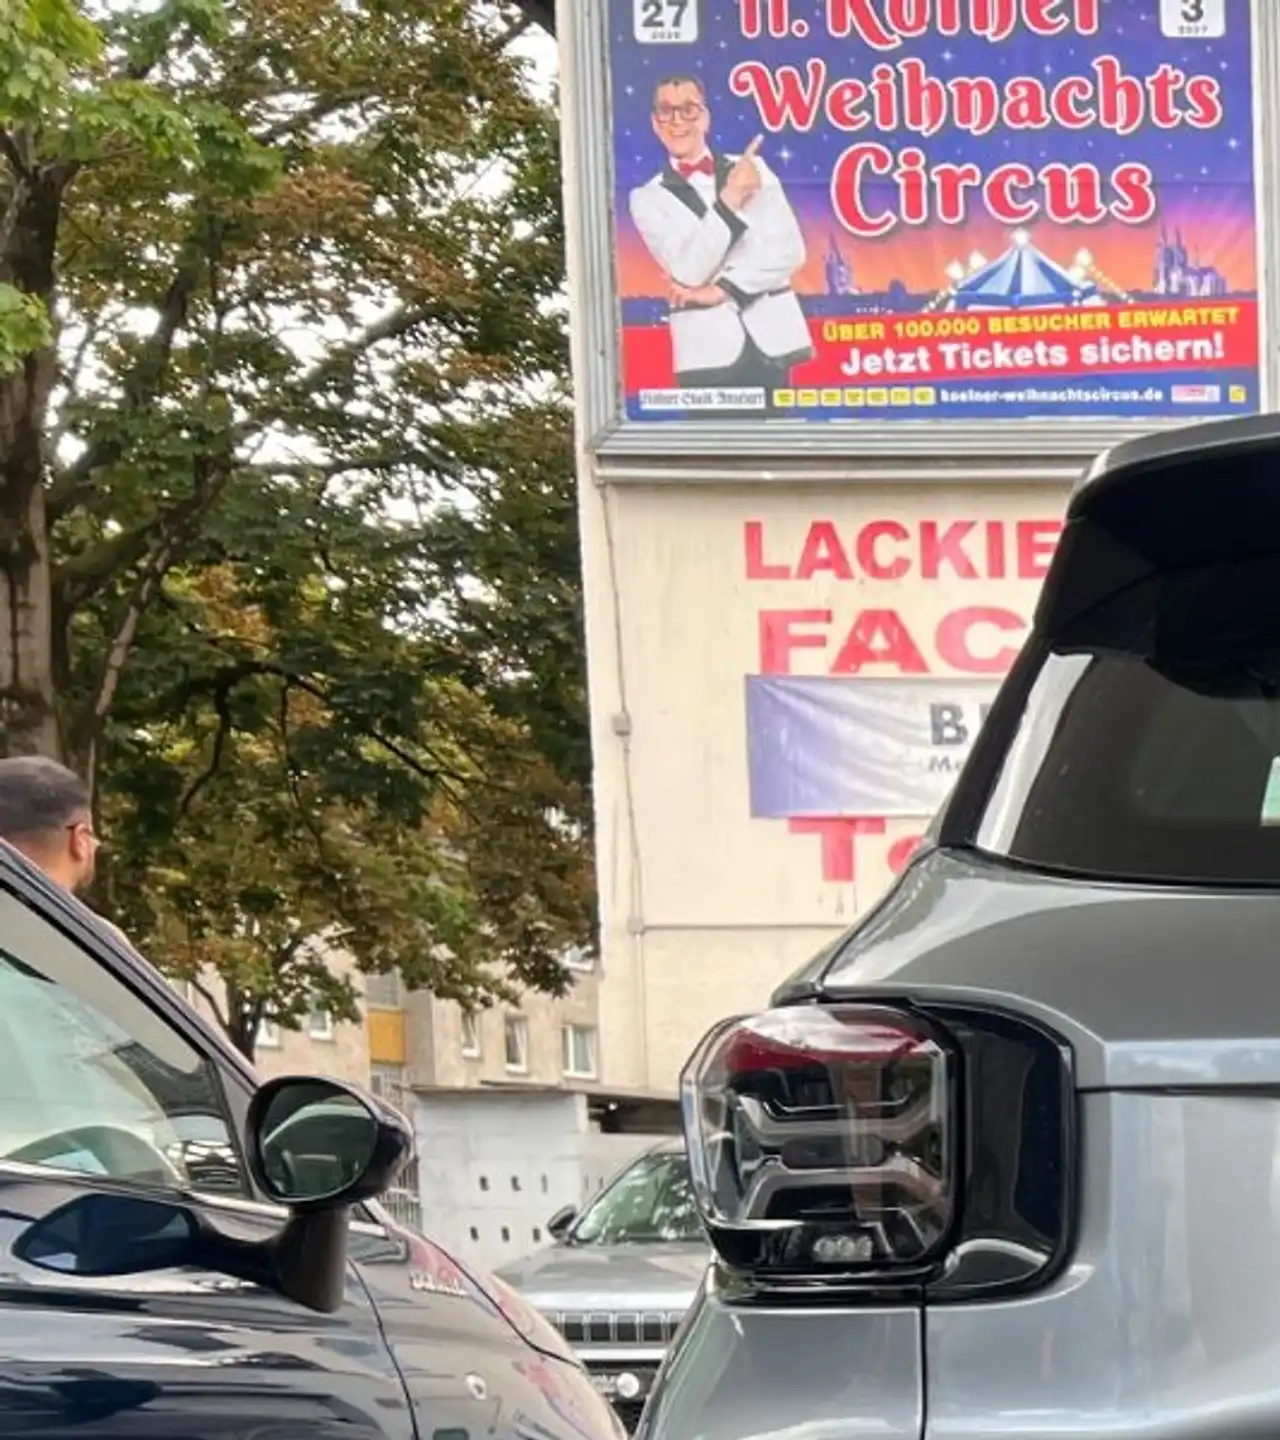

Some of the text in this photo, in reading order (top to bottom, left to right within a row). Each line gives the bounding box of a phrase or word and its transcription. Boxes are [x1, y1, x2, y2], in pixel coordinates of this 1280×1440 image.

[729, 55, 1223, 137] Weihnachts
[831, 141, 1156, 237] Circus
[823, 306, 1240, 342] ÜBER 100.000 BESUCHER ERWARTET
[841, 332, 1225, 376] Jetzt Tickets sichern!
[744, 520, 1064, 580] LACKIE
